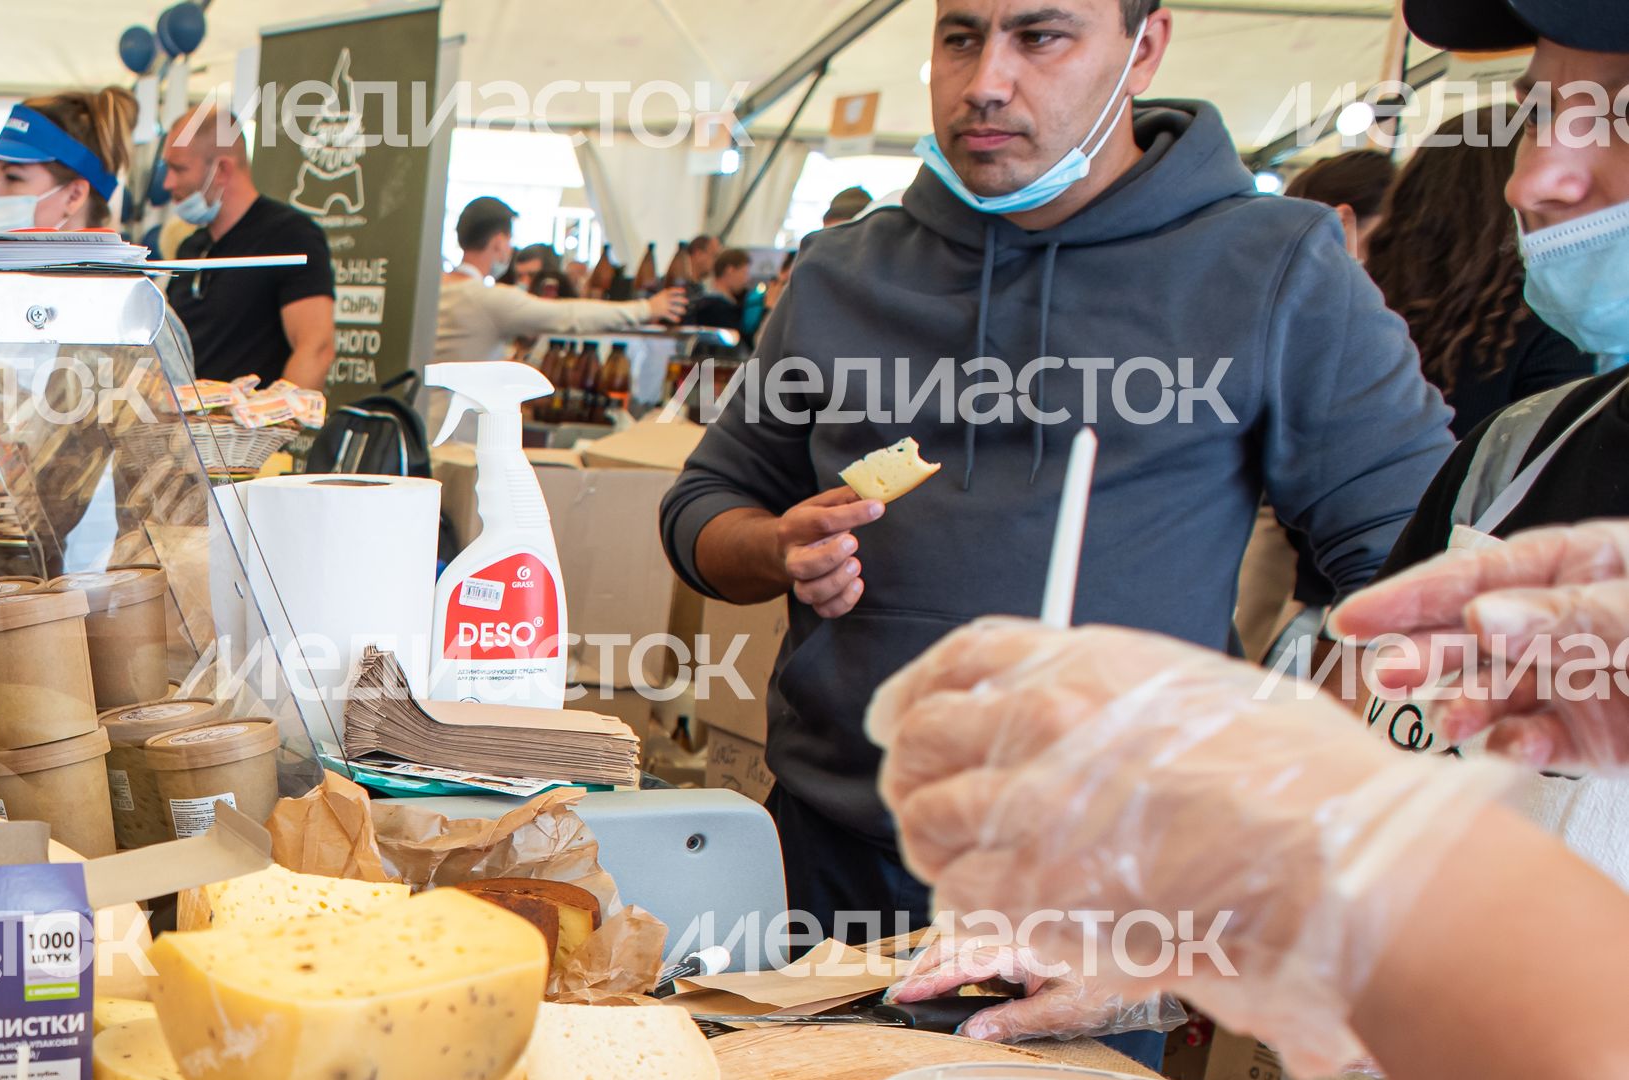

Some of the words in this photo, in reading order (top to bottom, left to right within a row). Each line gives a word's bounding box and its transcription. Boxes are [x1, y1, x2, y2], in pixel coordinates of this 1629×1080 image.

[335, 329, 381, 354] НОГО
[29, 932, 74, 949] 1000
[32, 952, 72, 964] ШТУК
